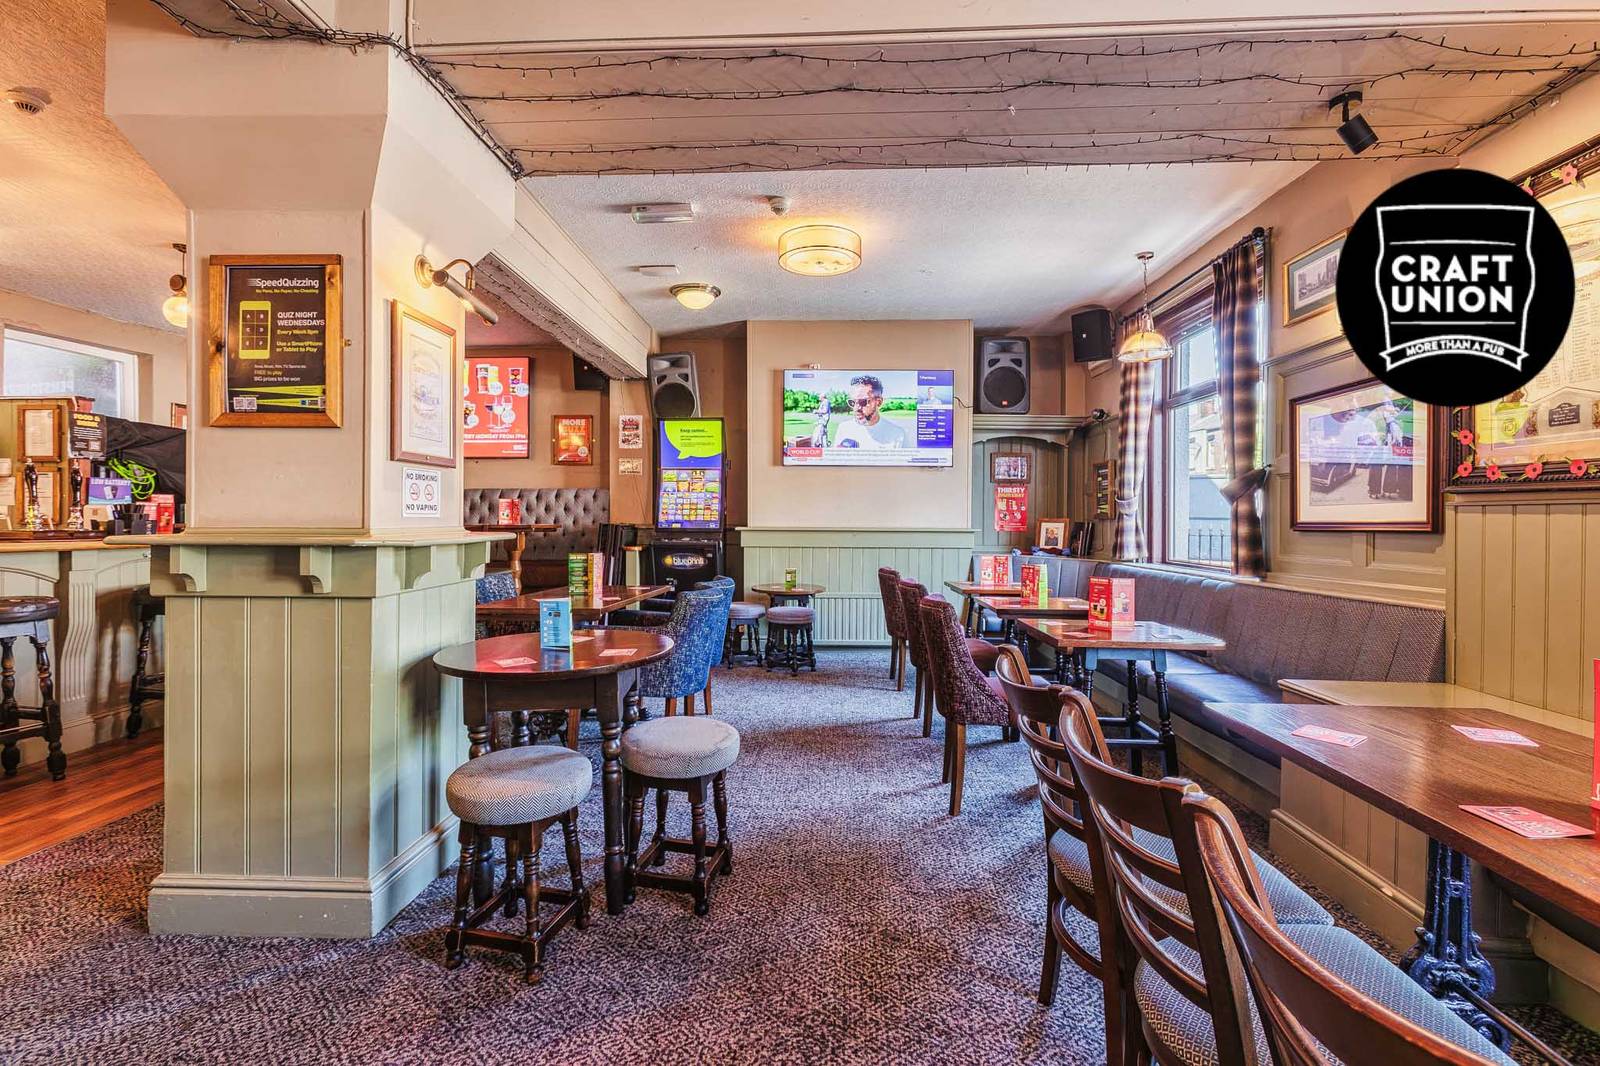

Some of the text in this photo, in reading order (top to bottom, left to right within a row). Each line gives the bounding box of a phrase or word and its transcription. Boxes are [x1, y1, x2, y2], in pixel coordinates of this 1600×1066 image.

[255, 278, 320, 288] SpeedQuizzing
[277, 319, 325, 327] WEDNESDAYS
[415, 474, 438, 482] SMOKING
